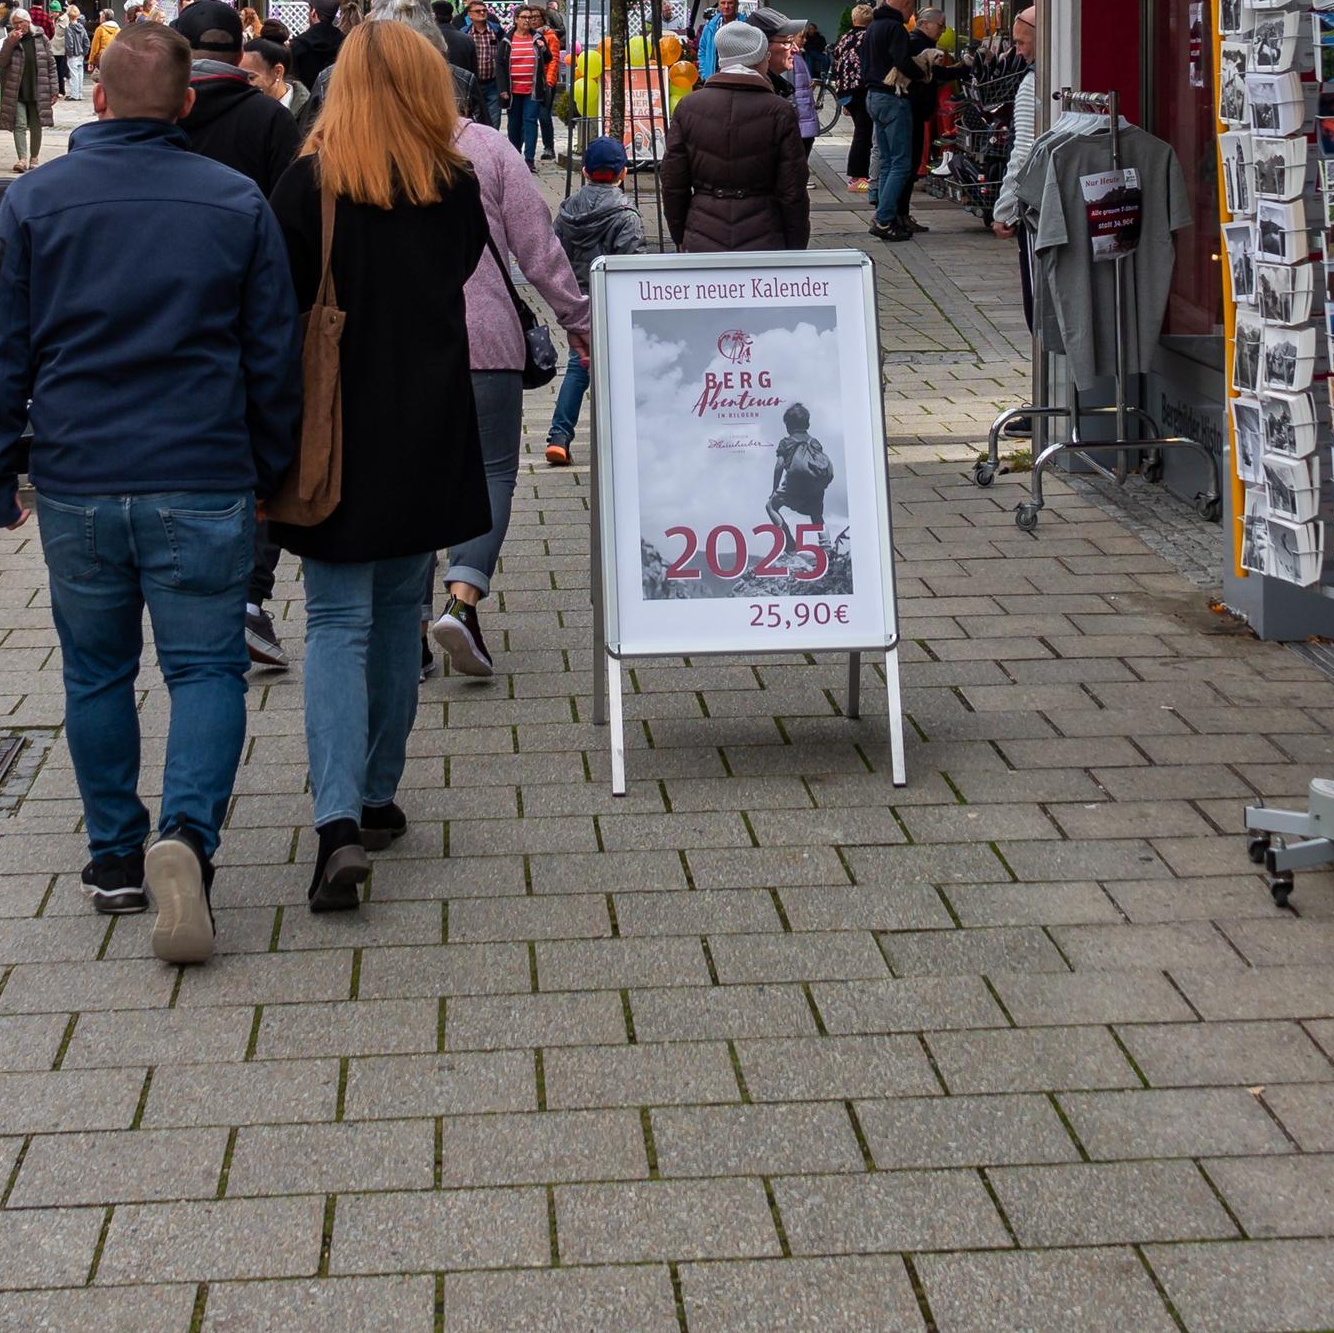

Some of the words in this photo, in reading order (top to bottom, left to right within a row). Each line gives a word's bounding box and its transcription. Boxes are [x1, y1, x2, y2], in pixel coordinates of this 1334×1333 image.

[638, 281, 690, 301] Unser
[696, 282, 746, 299] neuer
[751, 276, 830, 298] Kalender
[705, 370, 772, 389] BERG
[691, 380, 786, 418] Abenteuer
[664, 523, 829, 582] 2025
[749, 602, 850, 630] 25,90€
